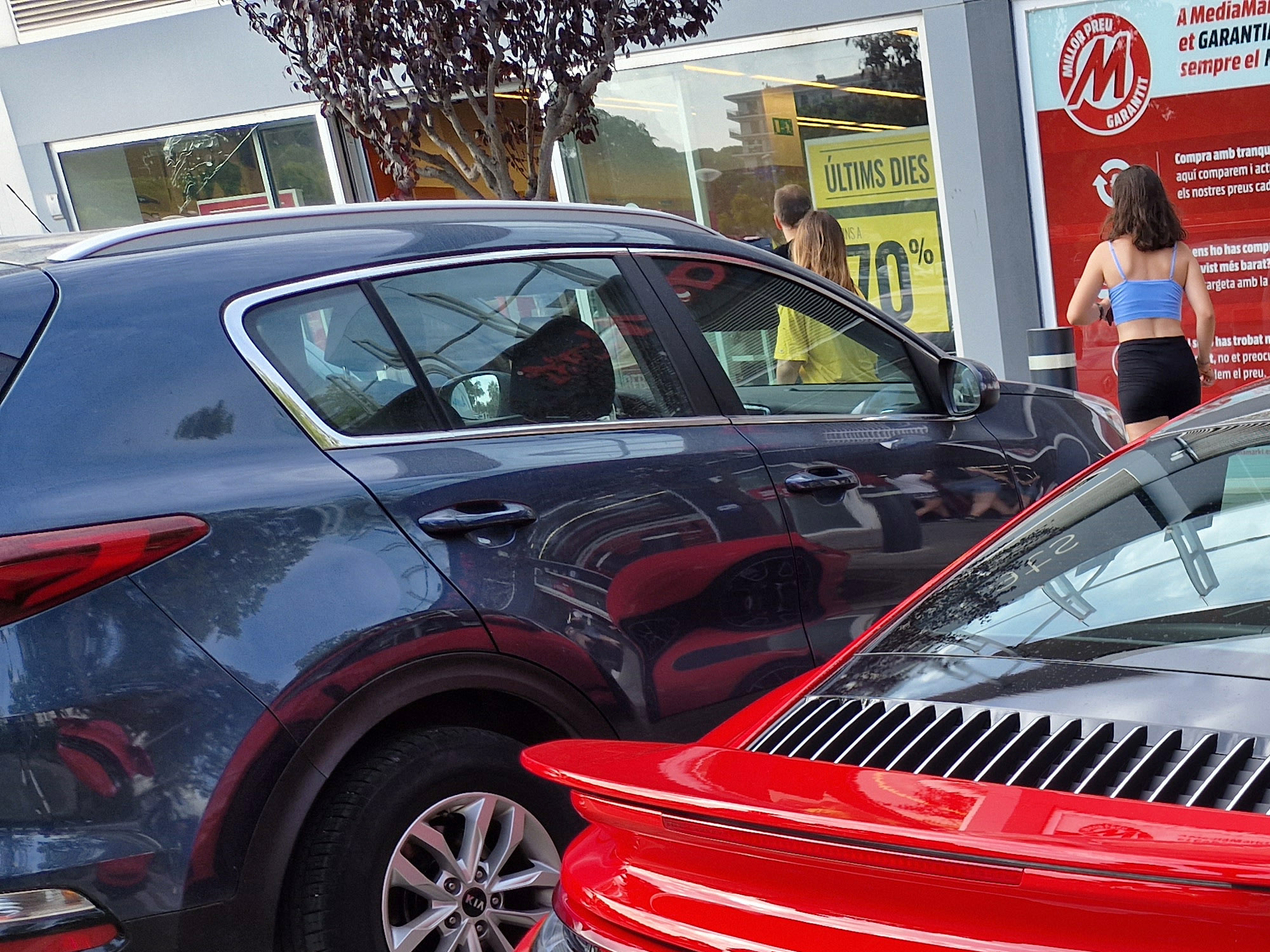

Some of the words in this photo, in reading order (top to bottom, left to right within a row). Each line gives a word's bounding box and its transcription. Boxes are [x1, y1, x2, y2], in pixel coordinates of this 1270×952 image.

[1177, 7, 1187, 26] A
[1062, 30, 1086, 78] MILLOR
[1083, 18, 1113, 37] PREU
[1178, 33, 1195, 52] et
[1180, 56, 1240, 77] sempre
[1244, 49, 1260, 68] el
[1106, 76, 1149, 128] GARANTIT
[1175, 151, 1211, 165] Compra
[1213, 148, 1235, 161] amb
[824, 155, 886, 194] ÚLTIMS
[889, 154, 931, 187] DIES
[1176, 168, 1197, 183] aquí
[1198, 165, 1248, 181] comparem
[1177, 187, 1190, 199] els
[1192, 185, 1226, 198] nostres
[1227, 183, 1254, 197] preus
[1210, 245, 1223, 257] ho
[1224, 244, 1241, 255] has
[1200, 262, 1218, 274] vist
[1219, 259, 1239, 272] més
[1240, 258, 1270, 271] barat?
[1237, 277, 1258, 288] amb
[1259, 275, 1268, 287] la
[1215, 335, 1231, 347] has
[1233, 334, 1264, 346] trobat
[1218, 353, 1230, 363] no
[1231, 352, 1241, 363] et
[1233, 368, 1241, 379] el
[1243, 368, 1266, 380] preu.
[465, 894, 484, 911] KIA
